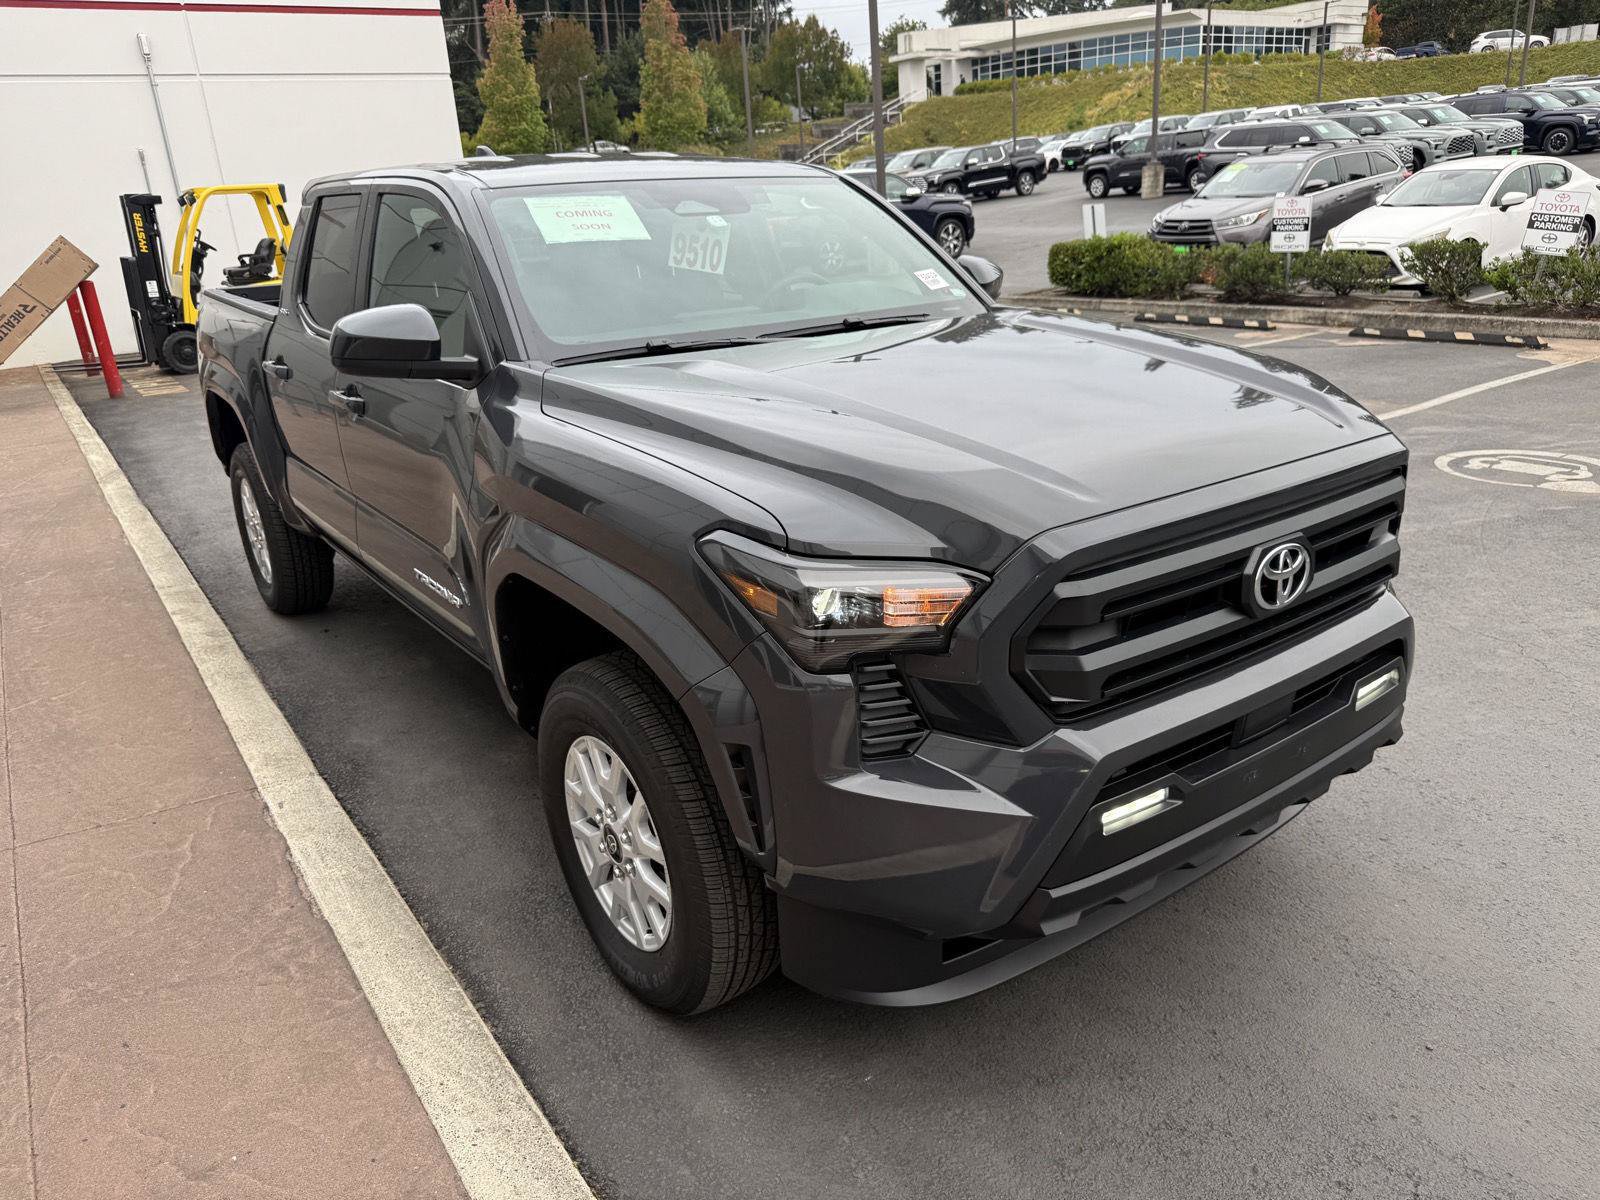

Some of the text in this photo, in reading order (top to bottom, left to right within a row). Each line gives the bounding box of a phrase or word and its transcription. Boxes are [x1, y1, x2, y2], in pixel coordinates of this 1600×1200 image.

[1276, 208, 1306, 216] TOYOTA
[1540, 203, 1580, 213] TOYOTA
[555, 209, 613, 219] COMING
[1531, 214, 1581, 224] CUSTOMER
[571, 222, 612, 231] SOON
[1533, 222, 1573, 231] PARKING
[133, 212, 149, 253] HYSTER
[672, 233, 722, 272] 9510
